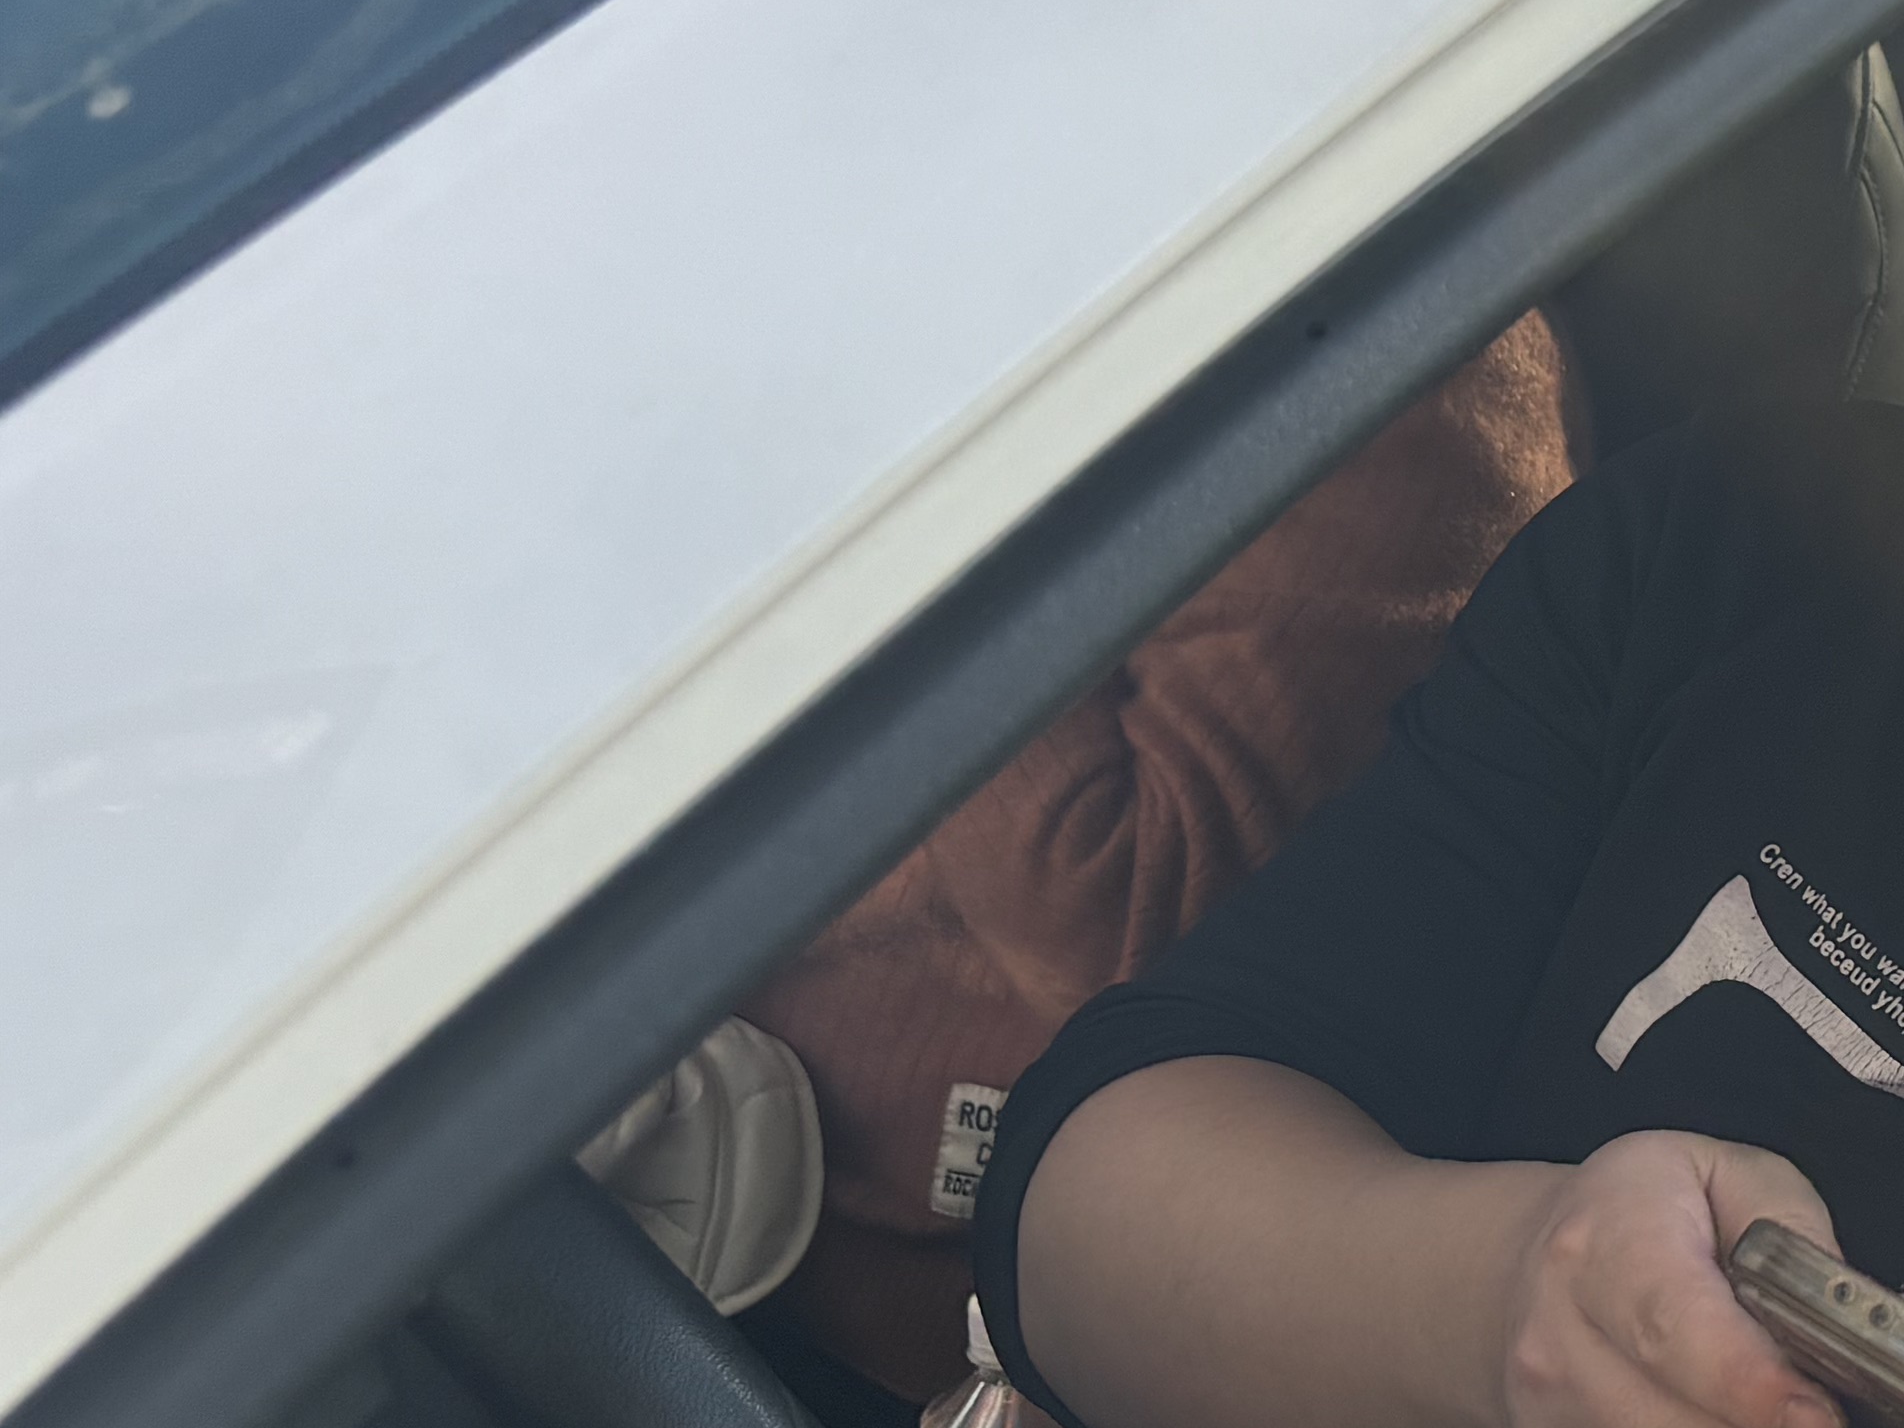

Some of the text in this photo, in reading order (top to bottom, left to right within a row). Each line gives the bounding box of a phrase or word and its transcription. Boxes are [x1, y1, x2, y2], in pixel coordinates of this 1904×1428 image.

[1760, 843, 1804, 890] Cren
[1801, 885, 1844, 930] what
[1836, 922, 1877, 961] you
[1808, 925, 1881, 996] beceud
